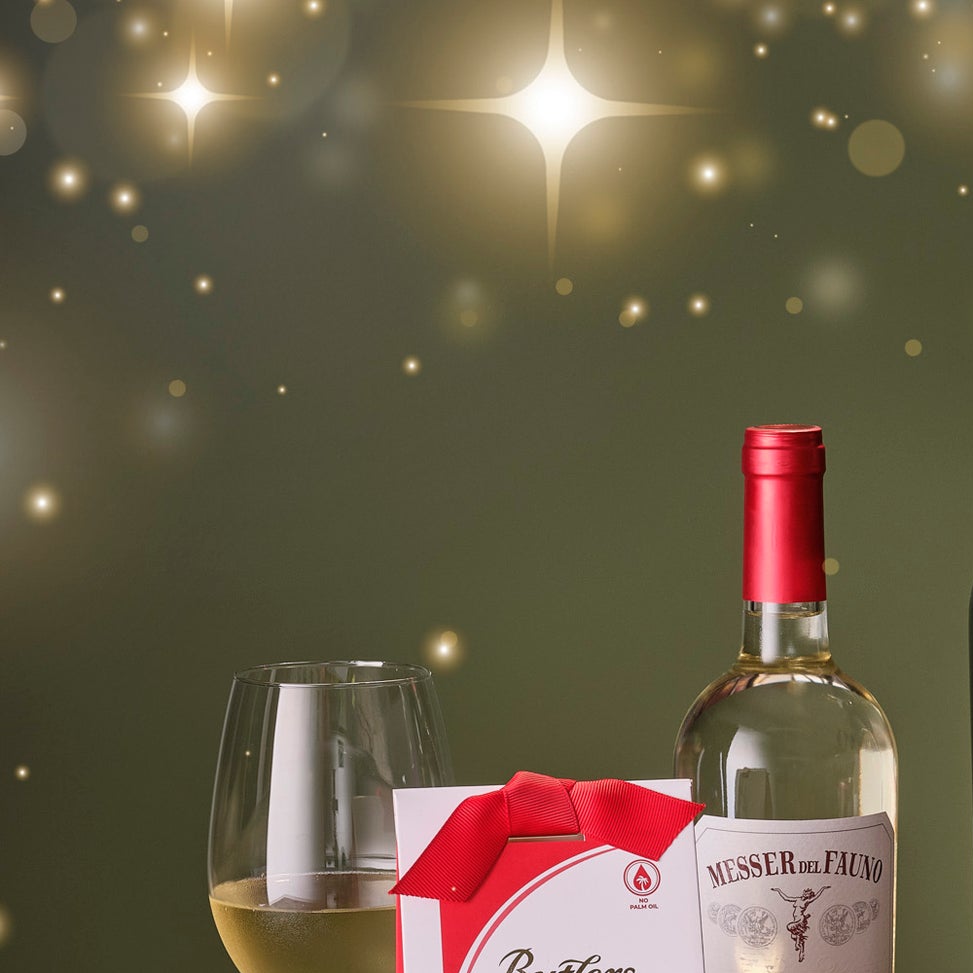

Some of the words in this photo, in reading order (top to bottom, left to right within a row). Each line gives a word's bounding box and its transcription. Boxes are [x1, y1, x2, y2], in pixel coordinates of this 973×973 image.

[706, 850, 796, 889] MESSER
[798, 860, 822, 875] DEL
[824, 850, 883, 884] FAUNO
